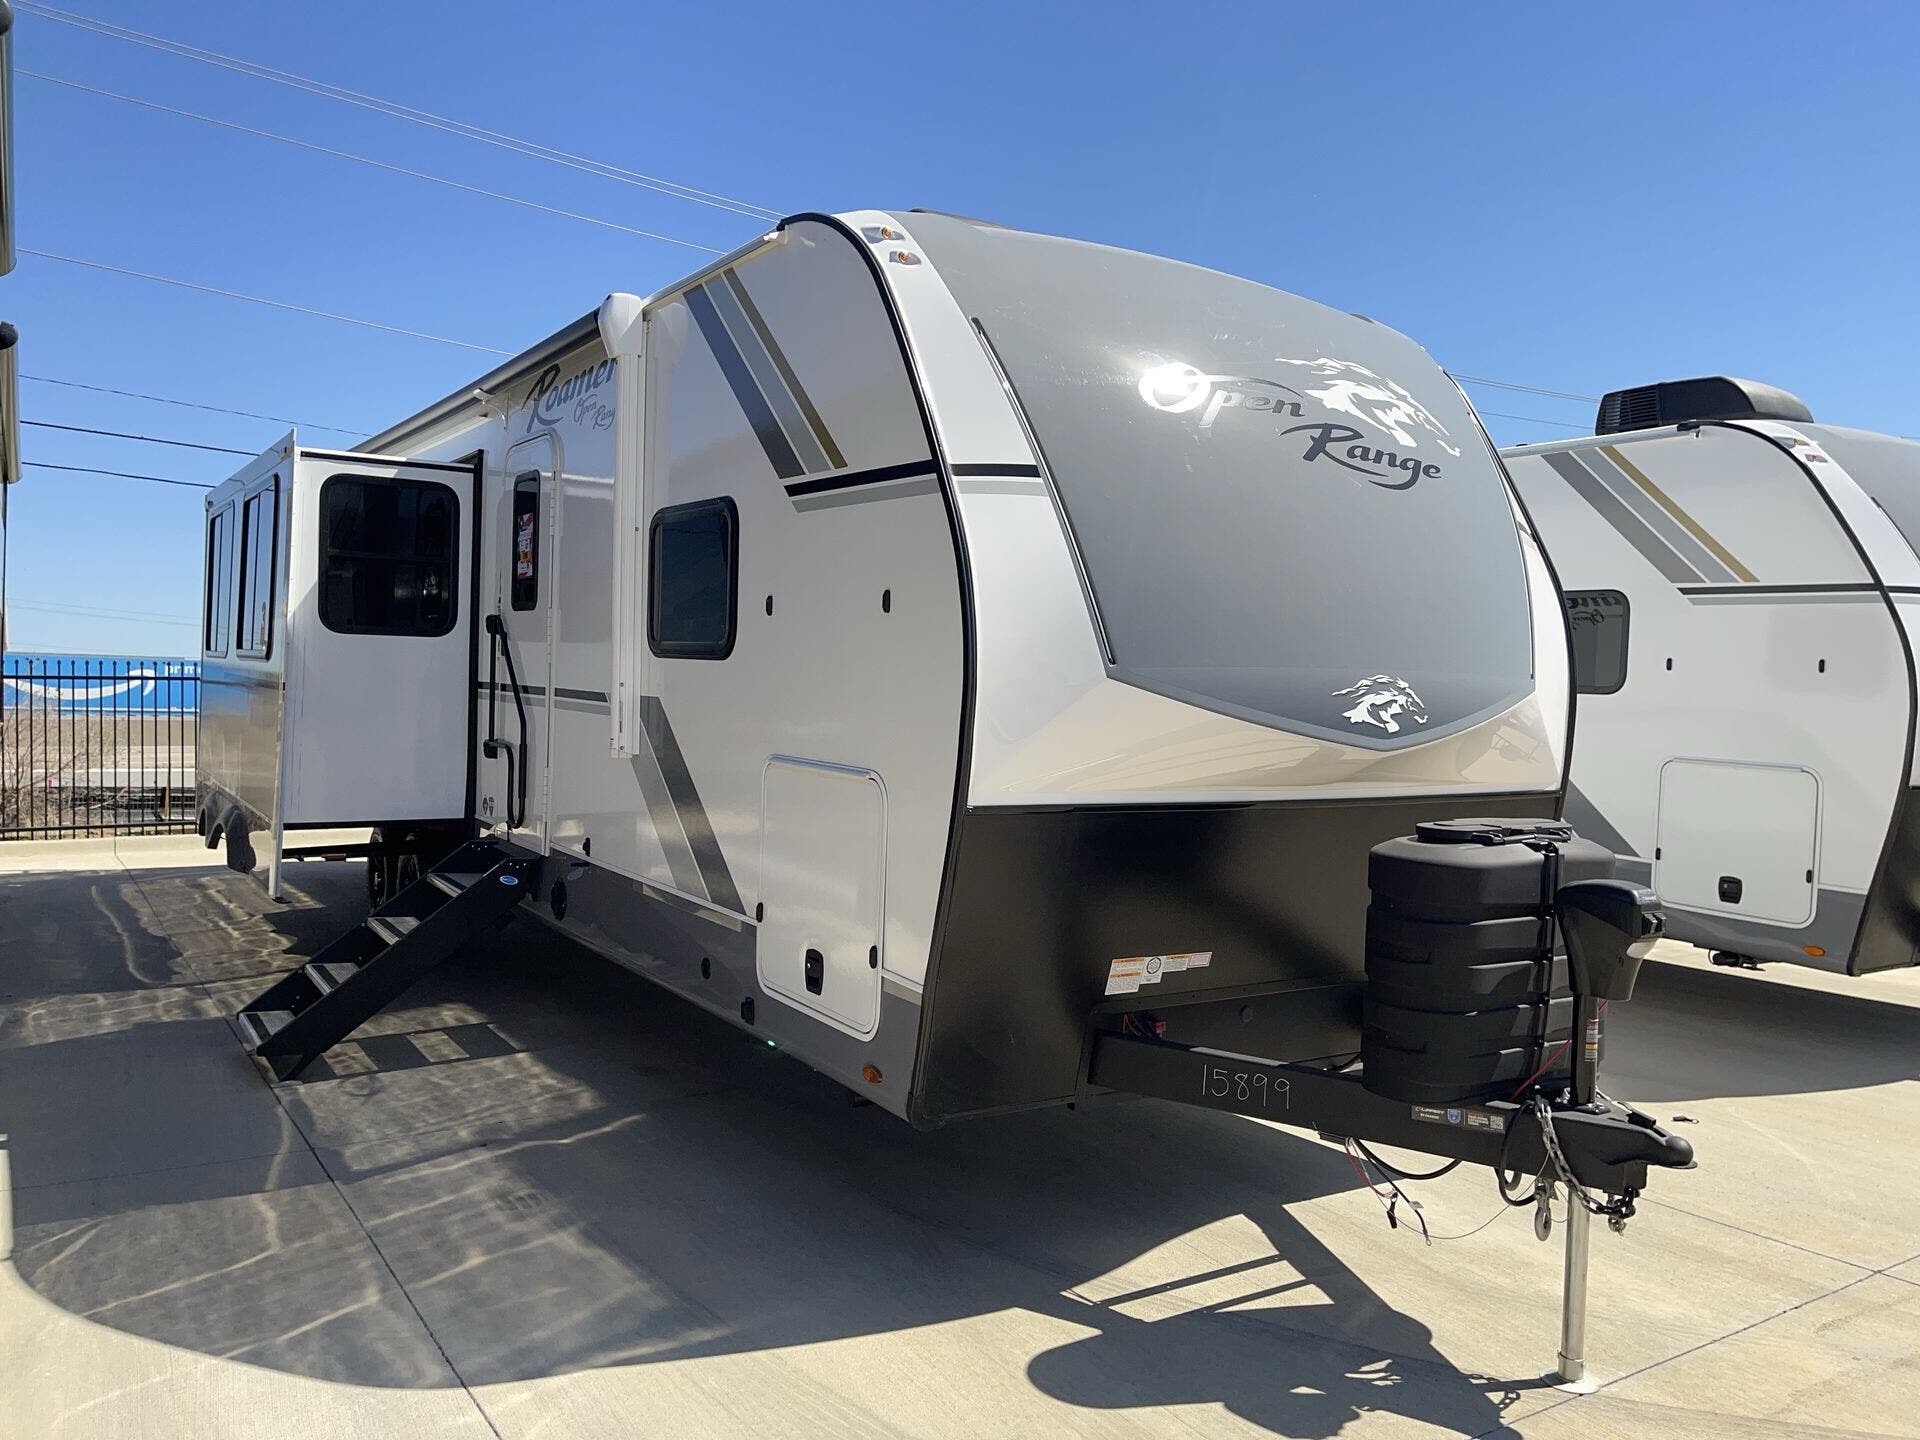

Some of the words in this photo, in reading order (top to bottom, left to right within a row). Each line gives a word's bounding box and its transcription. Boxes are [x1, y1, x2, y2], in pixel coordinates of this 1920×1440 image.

[521, 358, 617, 433] Roamer
[574, 394, 598, 426] Open
[592, 405, 616, 431] Rang
[1138, 362, 1306, 428] Open
[1280, 423, 1445, 490] Range
[1201, 1064, 1291, 1110] 15899
